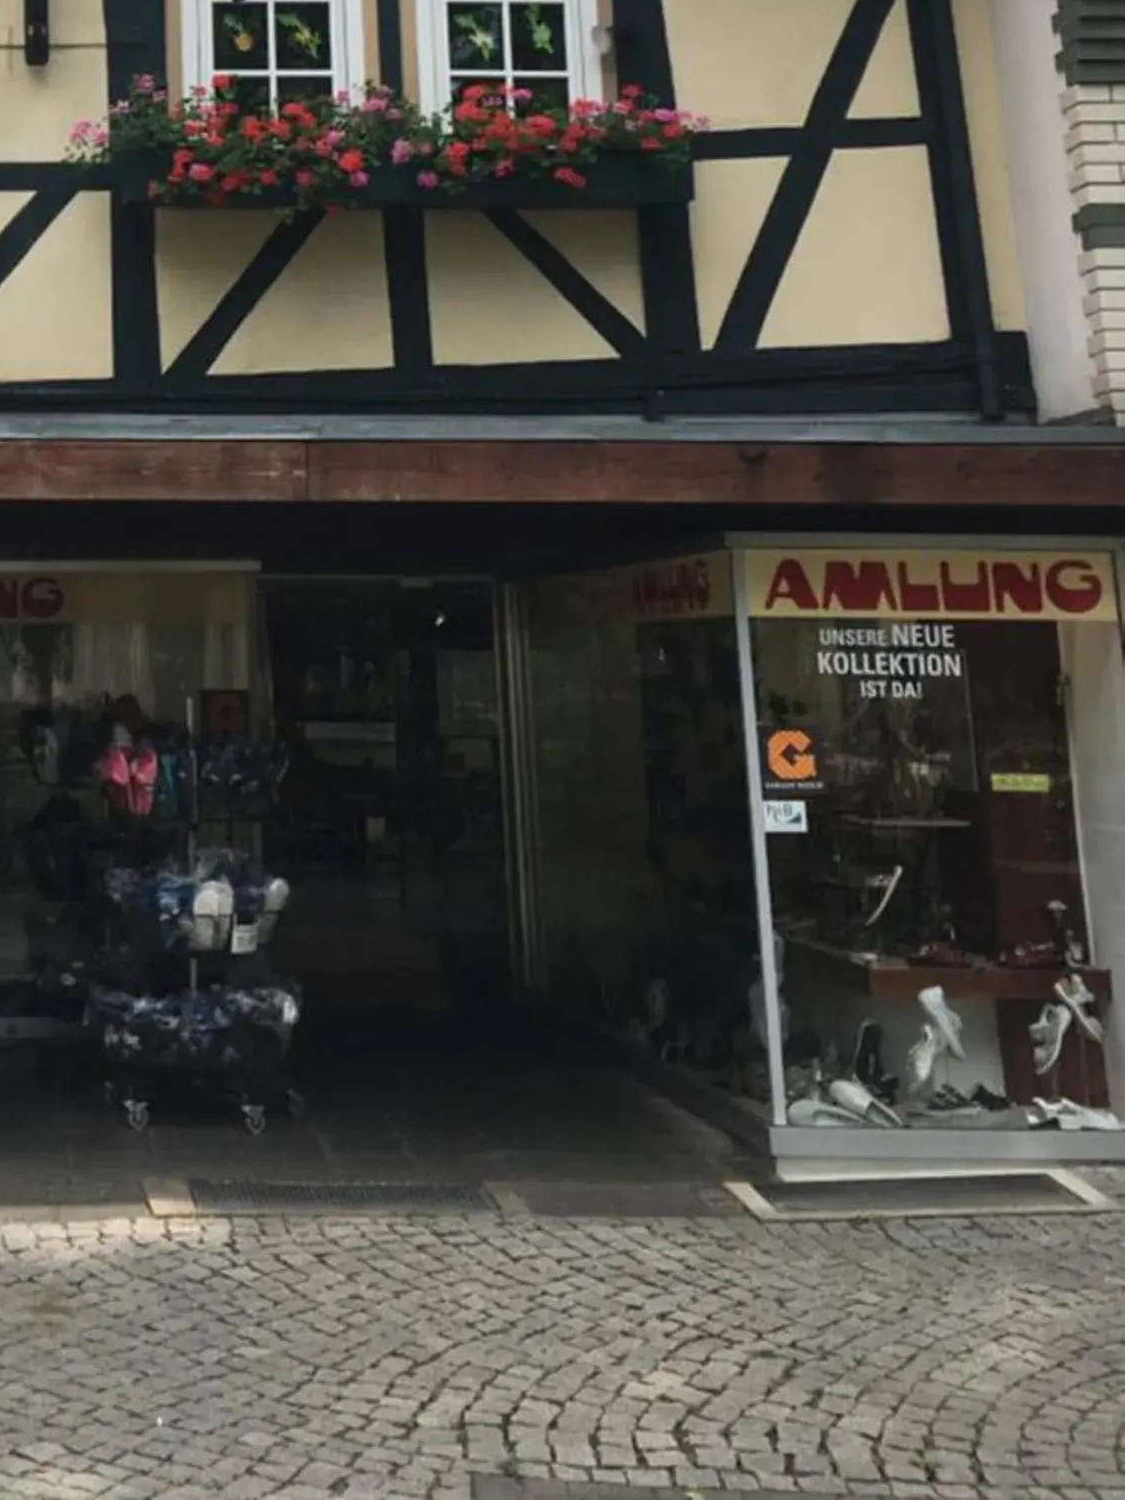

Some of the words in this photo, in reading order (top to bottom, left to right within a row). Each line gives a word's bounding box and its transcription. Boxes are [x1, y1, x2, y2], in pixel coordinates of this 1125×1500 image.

[764, 557, 1104, 614] AMLUNG
[819, 627, 889, 647] UNSERE
[891, 624, 956, 648] NEUE
[817, 651, 962, 677] KOLLEKTION
[859, 680, 886, 698] IST
[891, 681, 923, 699] DA!
